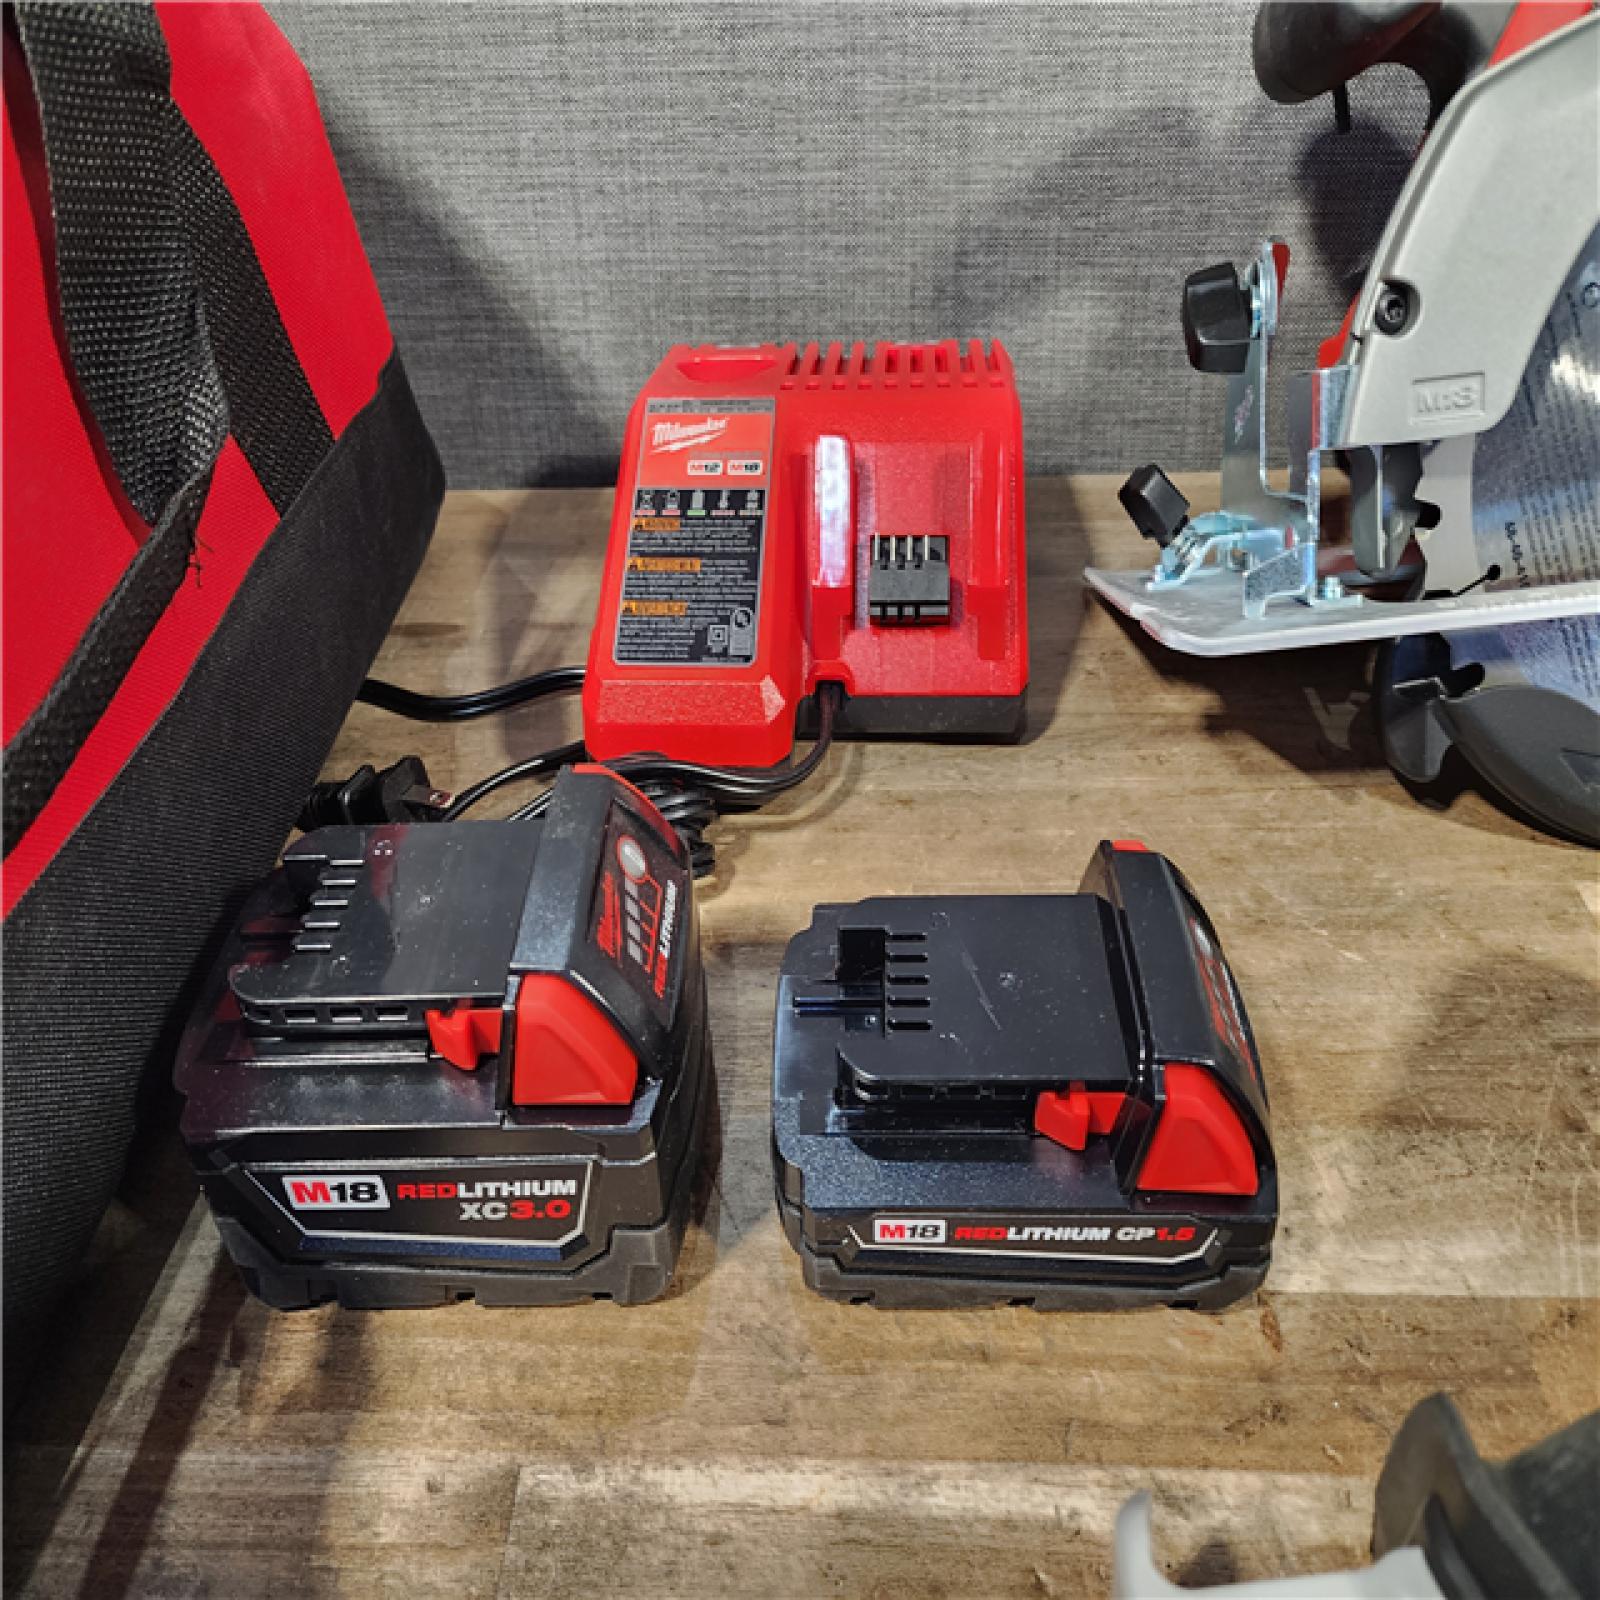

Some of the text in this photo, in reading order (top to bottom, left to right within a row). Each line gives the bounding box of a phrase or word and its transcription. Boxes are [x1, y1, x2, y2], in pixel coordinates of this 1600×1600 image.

[289, 1179, 577, 1203] M18 REDLITHIUM
[459, 1199, 571, 1221] XC3.0
[879, 1224, 941, 1239] M18
[954, 1225, 1111, 1241] REDLITHIUM
